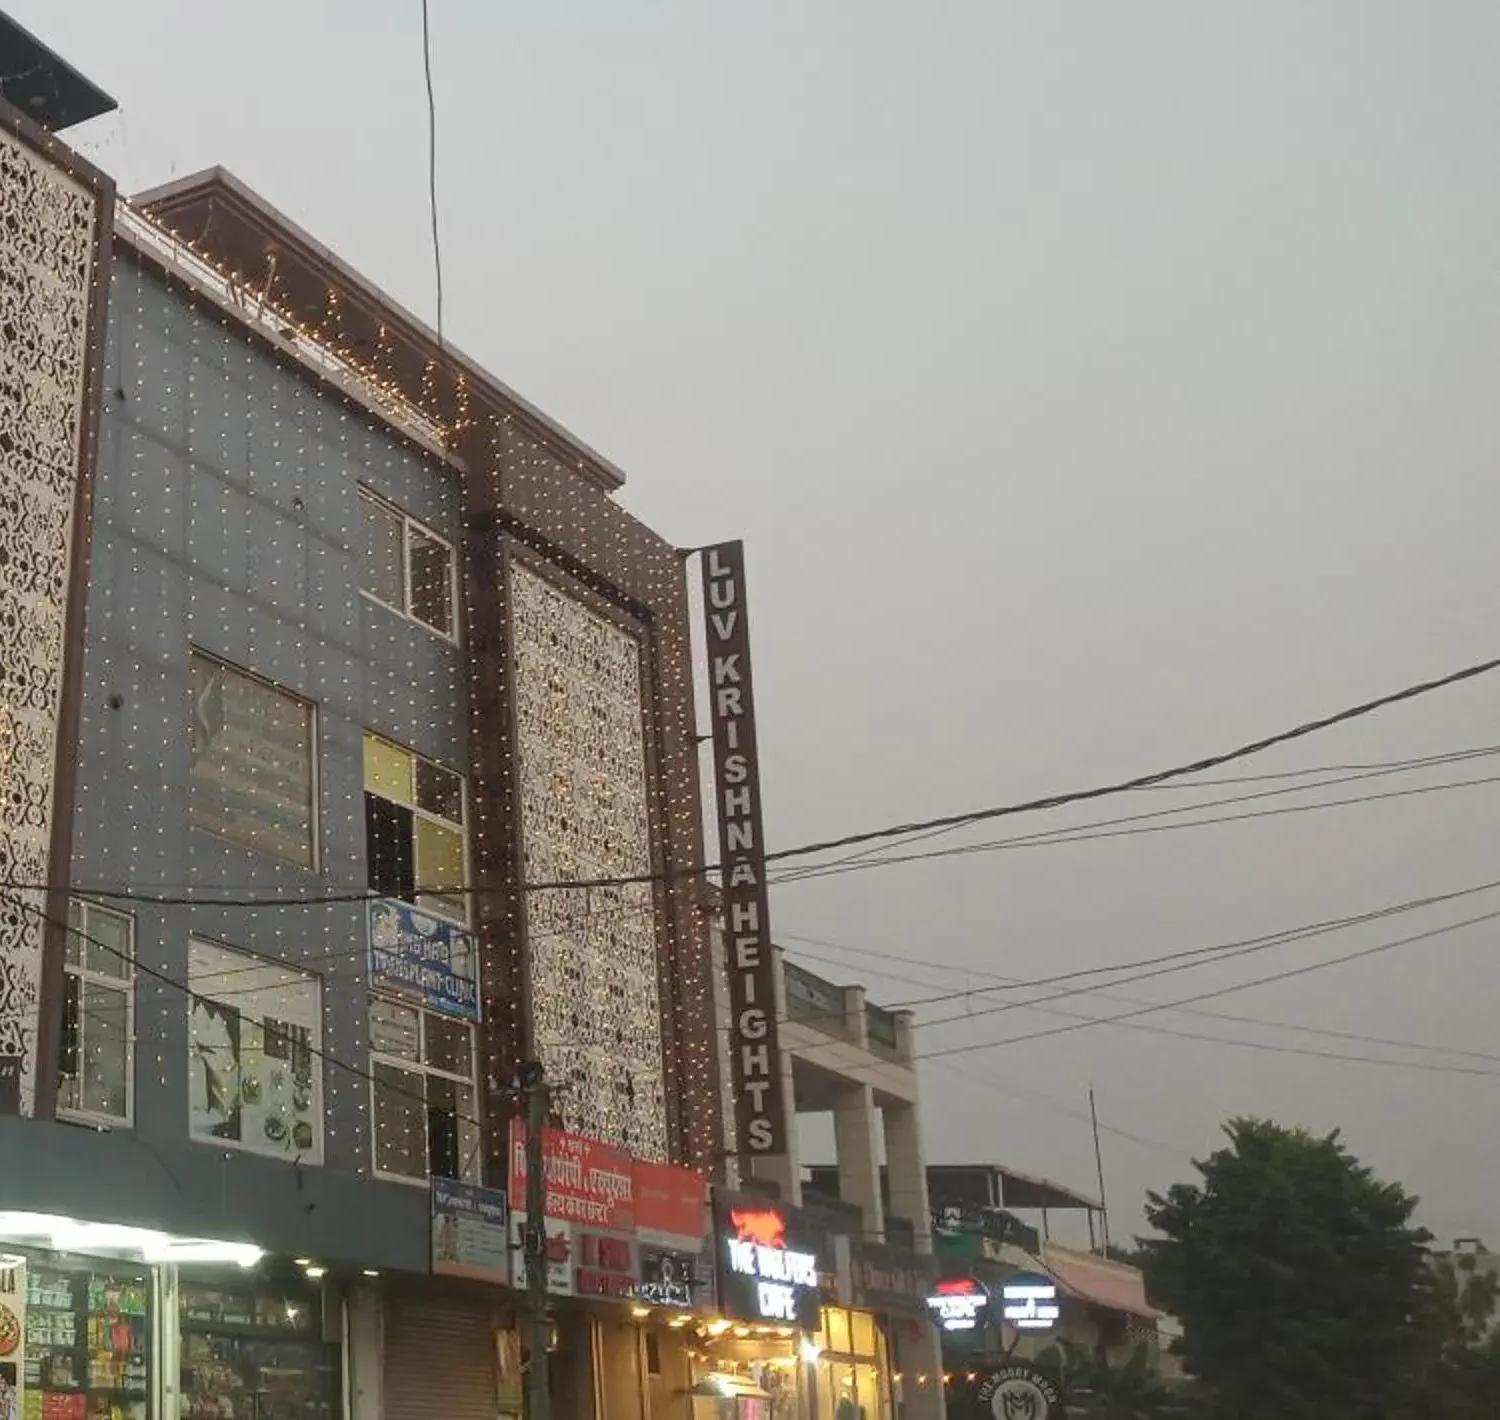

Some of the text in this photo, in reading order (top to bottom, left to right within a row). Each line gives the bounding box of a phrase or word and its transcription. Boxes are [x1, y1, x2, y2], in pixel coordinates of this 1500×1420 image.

[707, 550, 773, 1152] LUV KRISHNA HEIGHTS
